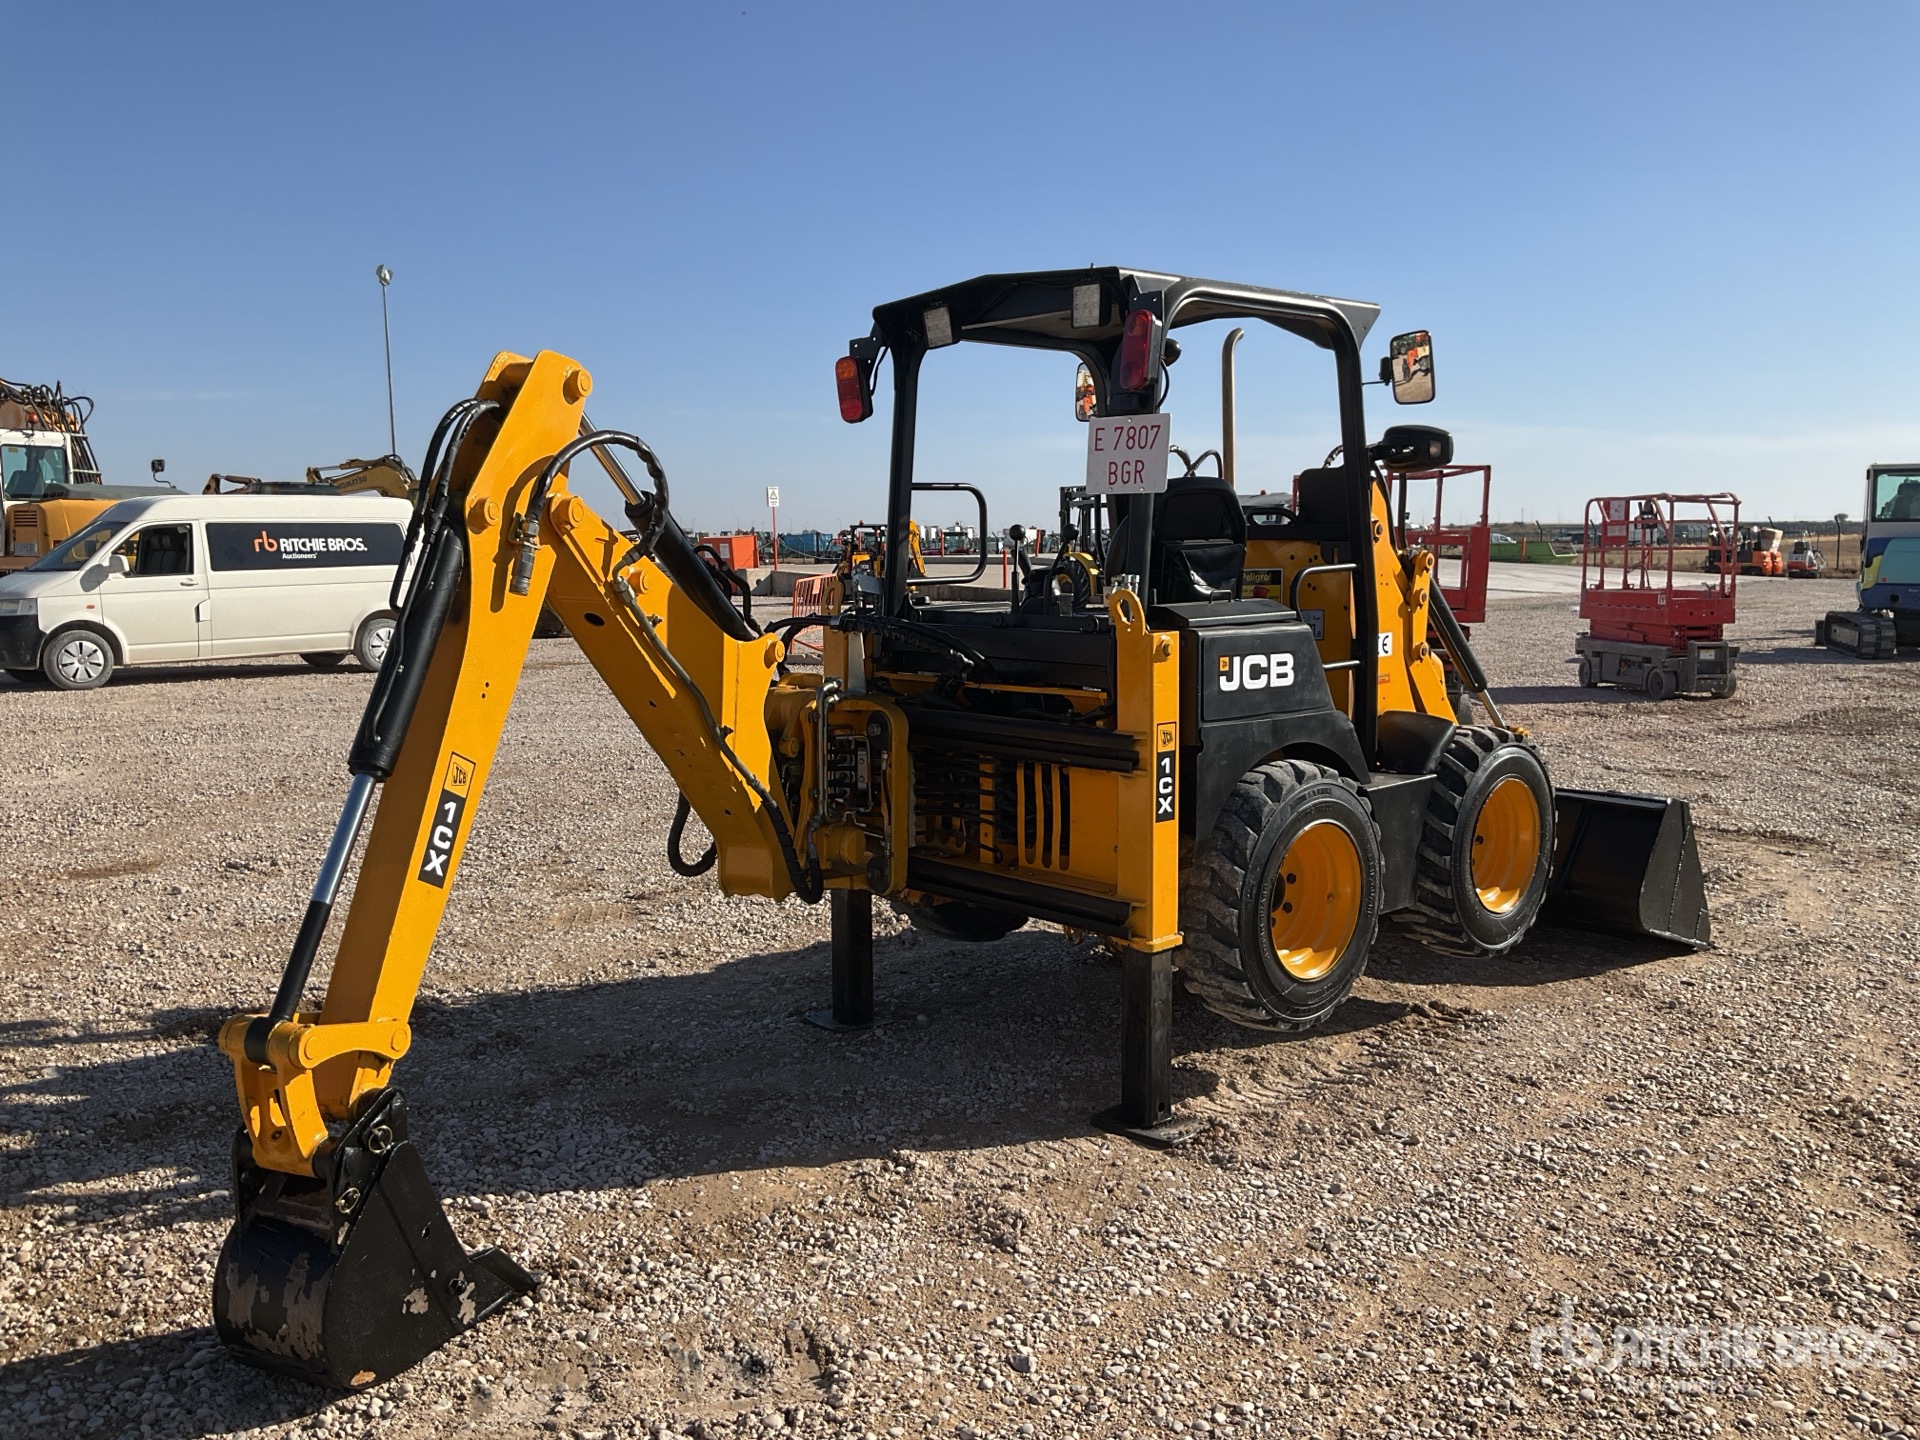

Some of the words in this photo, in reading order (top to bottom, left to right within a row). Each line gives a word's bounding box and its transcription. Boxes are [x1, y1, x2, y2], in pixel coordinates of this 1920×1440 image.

[1094, 427, 1105, 452] E
[1113, 424, 1161, 451] 7807
[1108, 459, 1145, 486] BGR
[279, 538, 328, 552] RITCHIE
[328, 538, 368, 552] BROS.
[282, 552, 317, 560] Auctioneers
[1219, 652, 1295, 692] JCB
[453, 765, 467, 785] JCB
[1157, 757, 1173, 814] 1CX
[423, 801, 457, 877] 1CX
